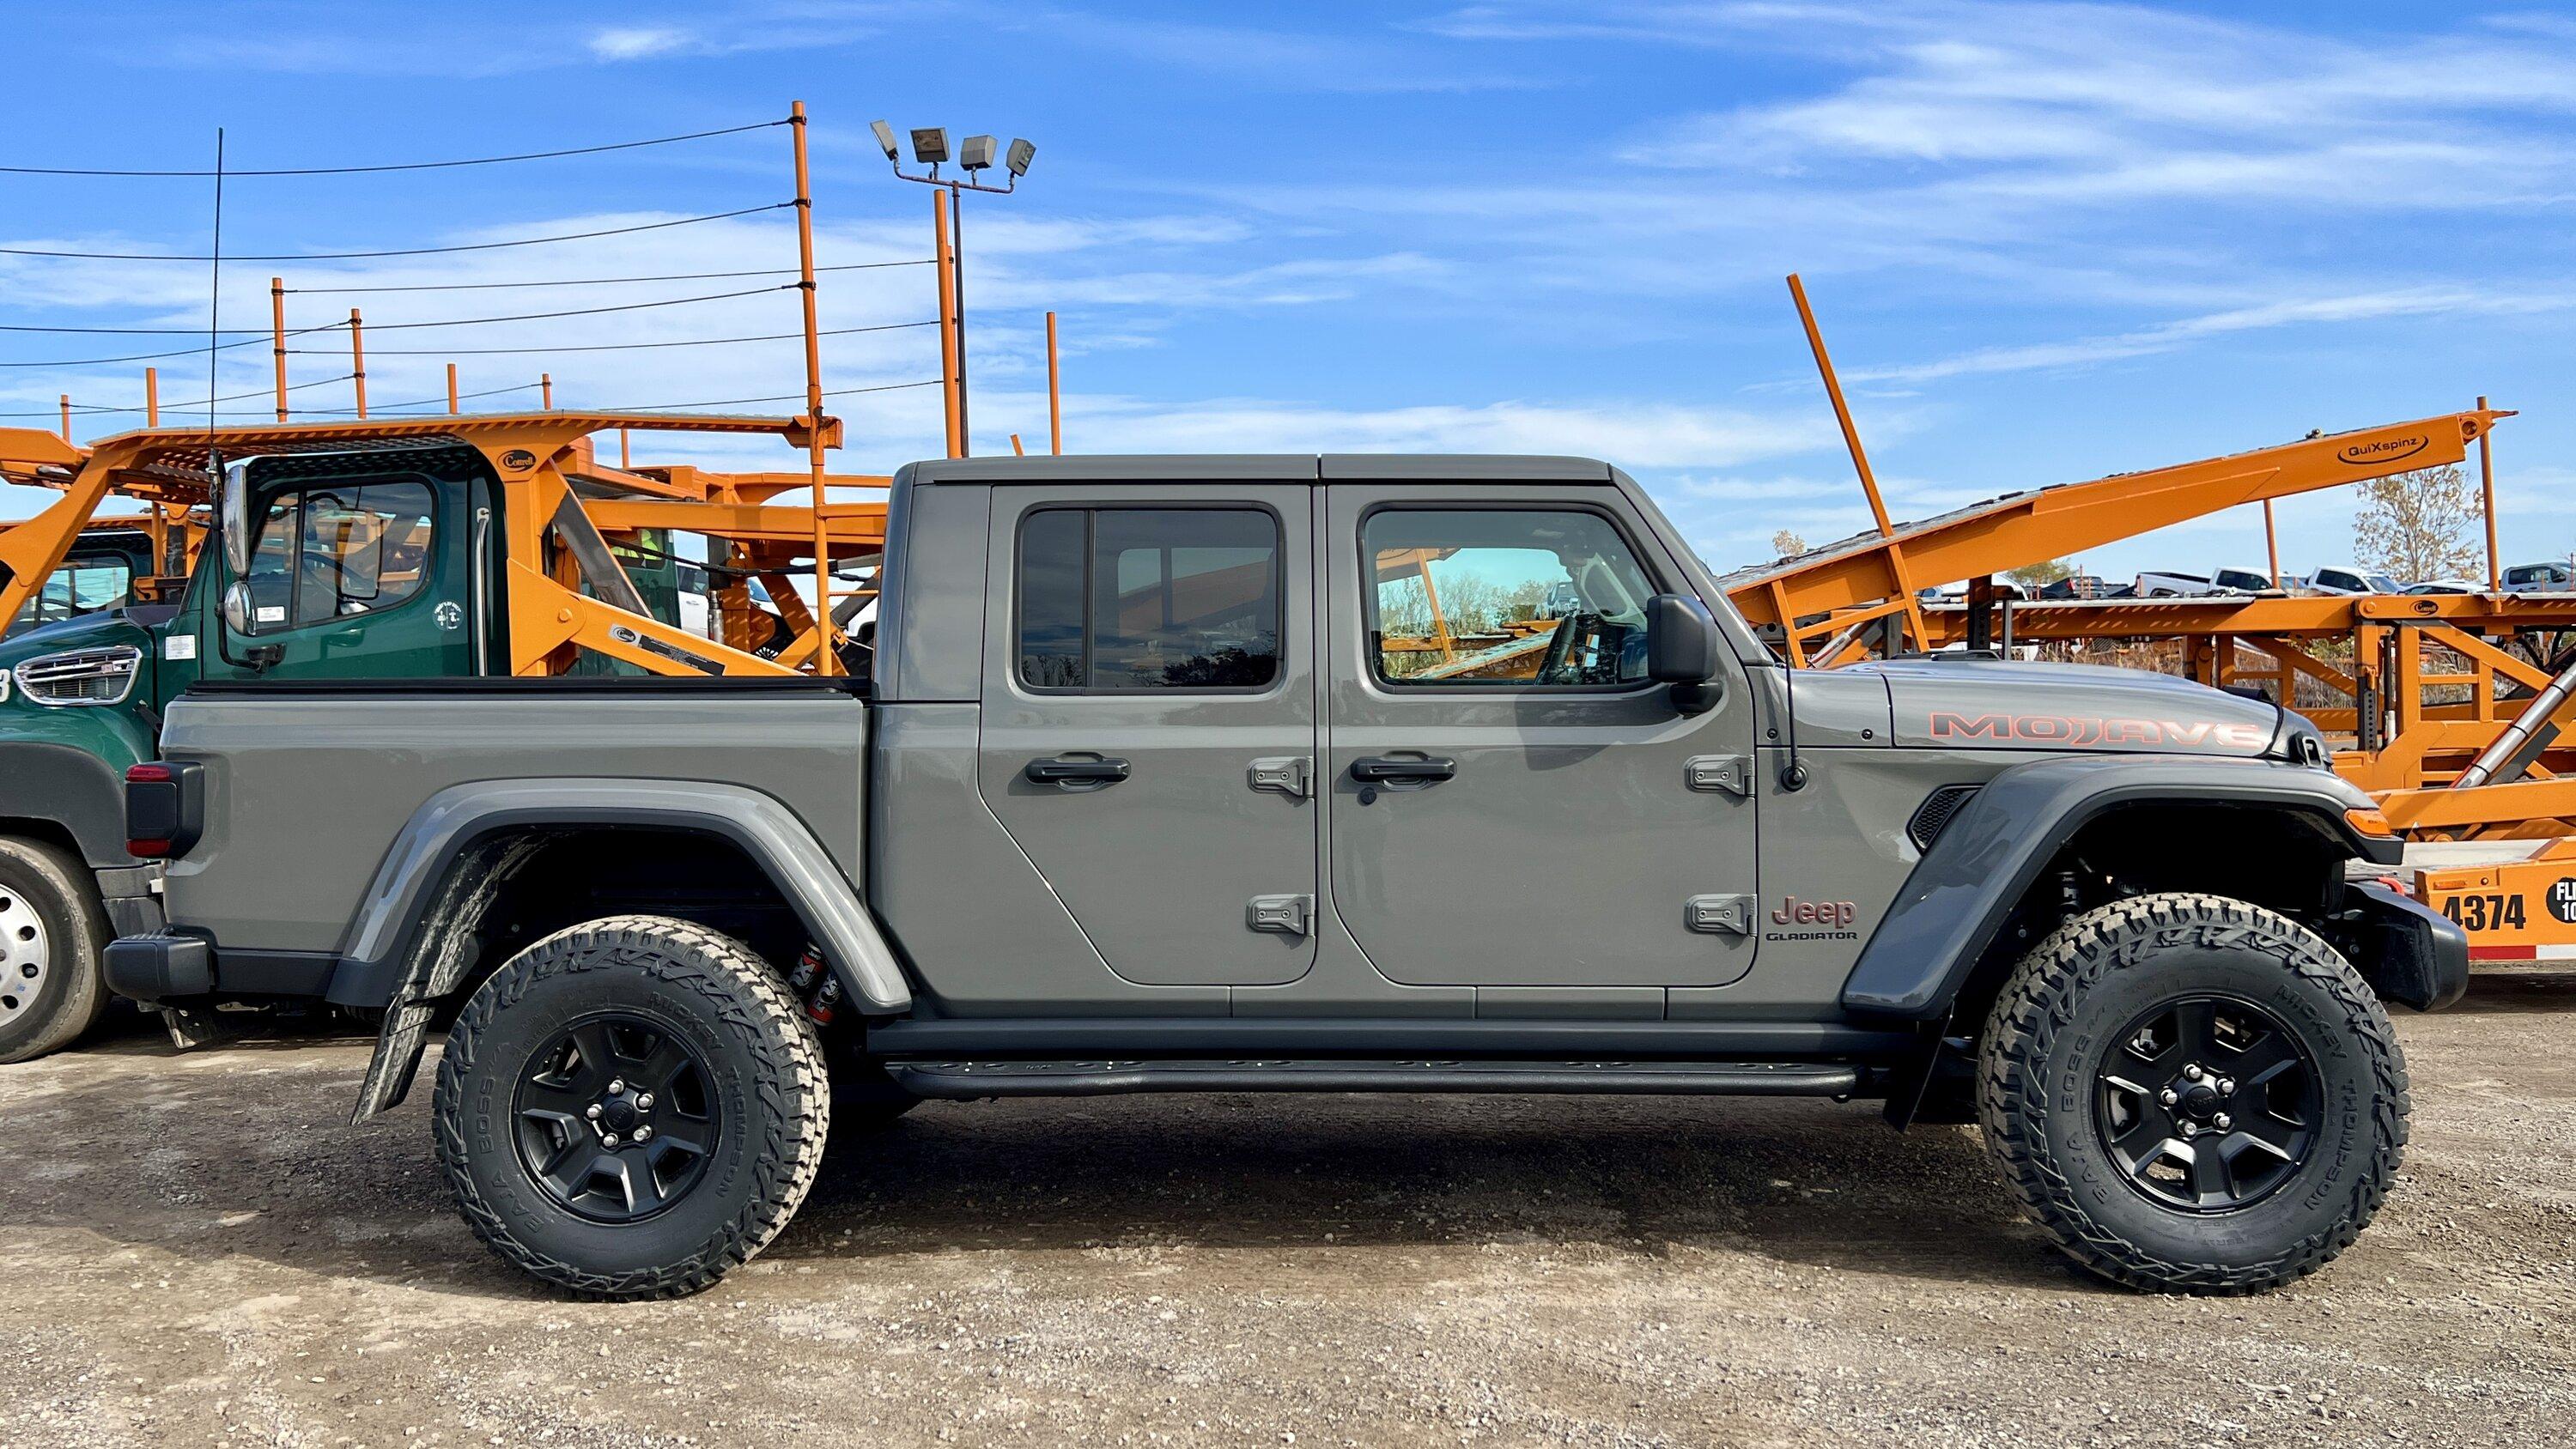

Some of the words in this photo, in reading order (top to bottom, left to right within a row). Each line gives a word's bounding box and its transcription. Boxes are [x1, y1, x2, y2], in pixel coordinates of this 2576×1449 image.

[2348, 437, 2417, 458] QuiXspinz
[1929, 712, 2267, 749] MOJAVE
[1771, 895, 1857, 930] Jeep
[2442, 894, 2527, 931] 4374
[1765, 931, 1858, 942] GLADIATOR
